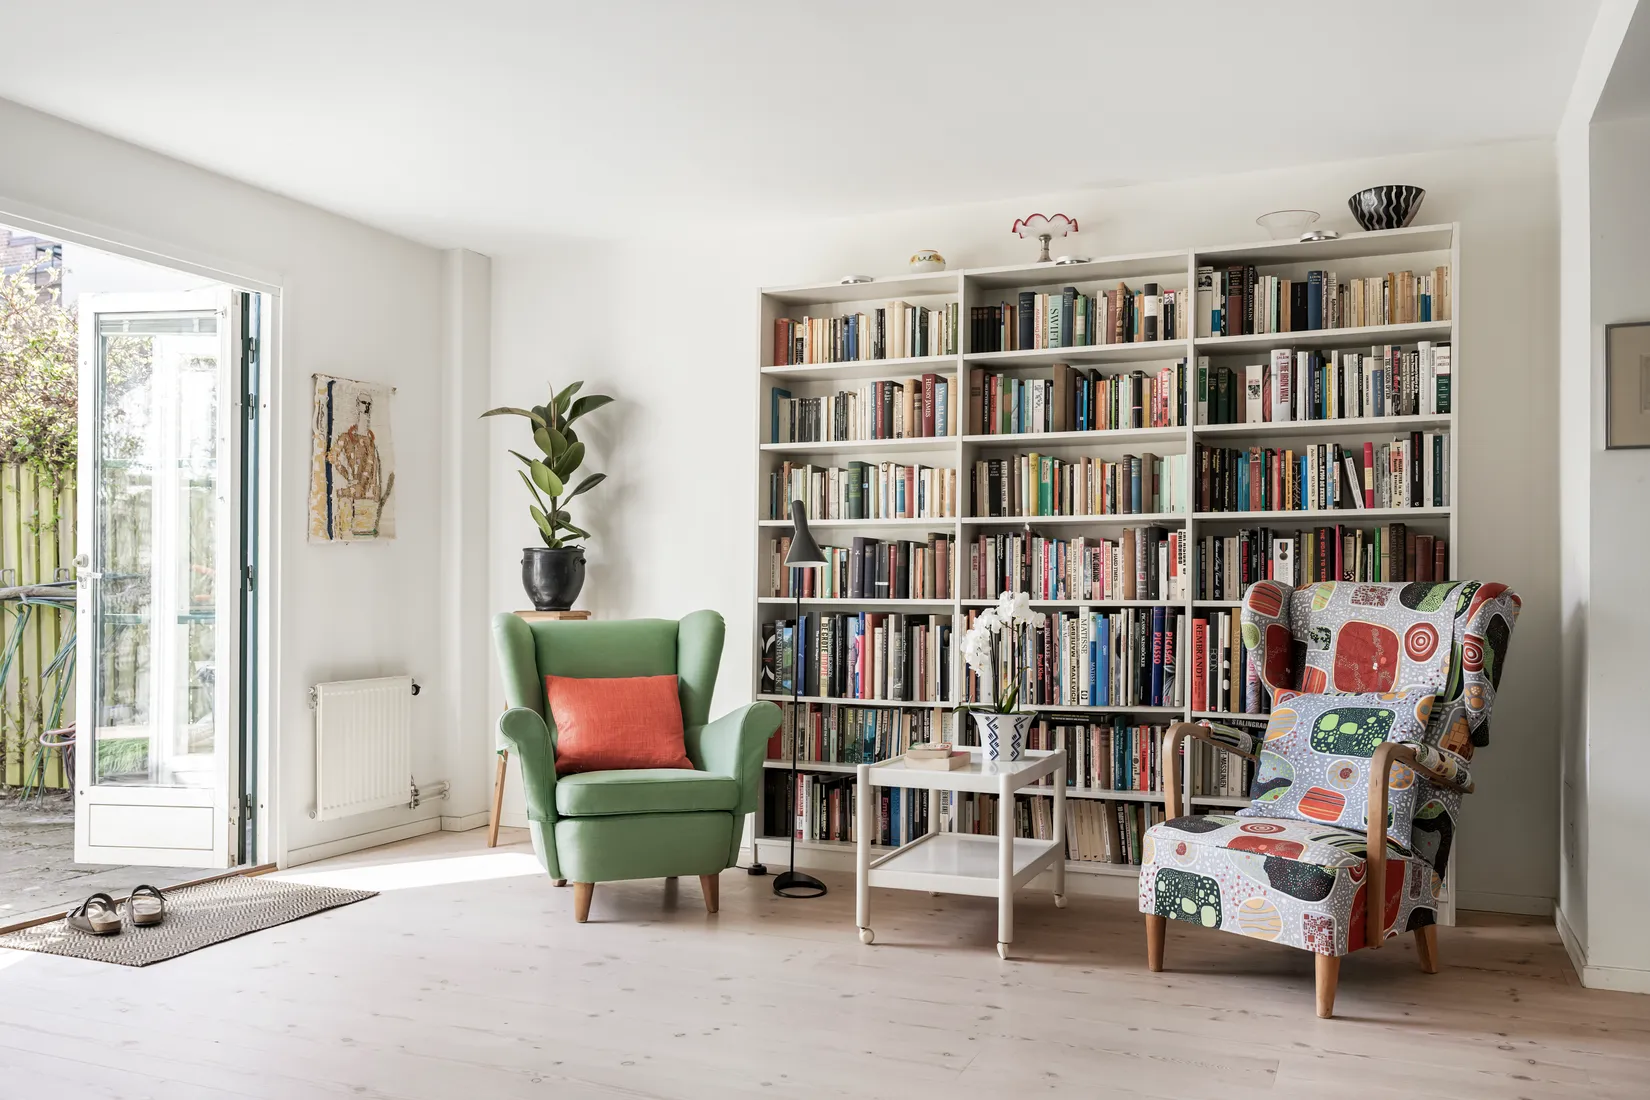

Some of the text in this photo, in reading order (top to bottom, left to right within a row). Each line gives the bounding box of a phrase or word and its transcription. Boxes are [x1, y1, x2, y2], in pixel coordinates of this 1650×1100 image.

[1050, 308, 1059, 343] SWIFT
[1280, 361, 1289, 404] THE IRON WALL
[937, 387, 945, 437] Wm. BLAKE
[821, 623, 828, 631] DE
[775, 628, 783, 685] KONSTHANTVERK
[1154, 631, 1162, 665] PICASSO
[1165, 631, 1173, 664] PICASSO
[1195, 624, 1203, 680] REMBRANDT
[1231, 719, 1267, 729] STALINGRAD
[881, 797, 889, 831] Empire
